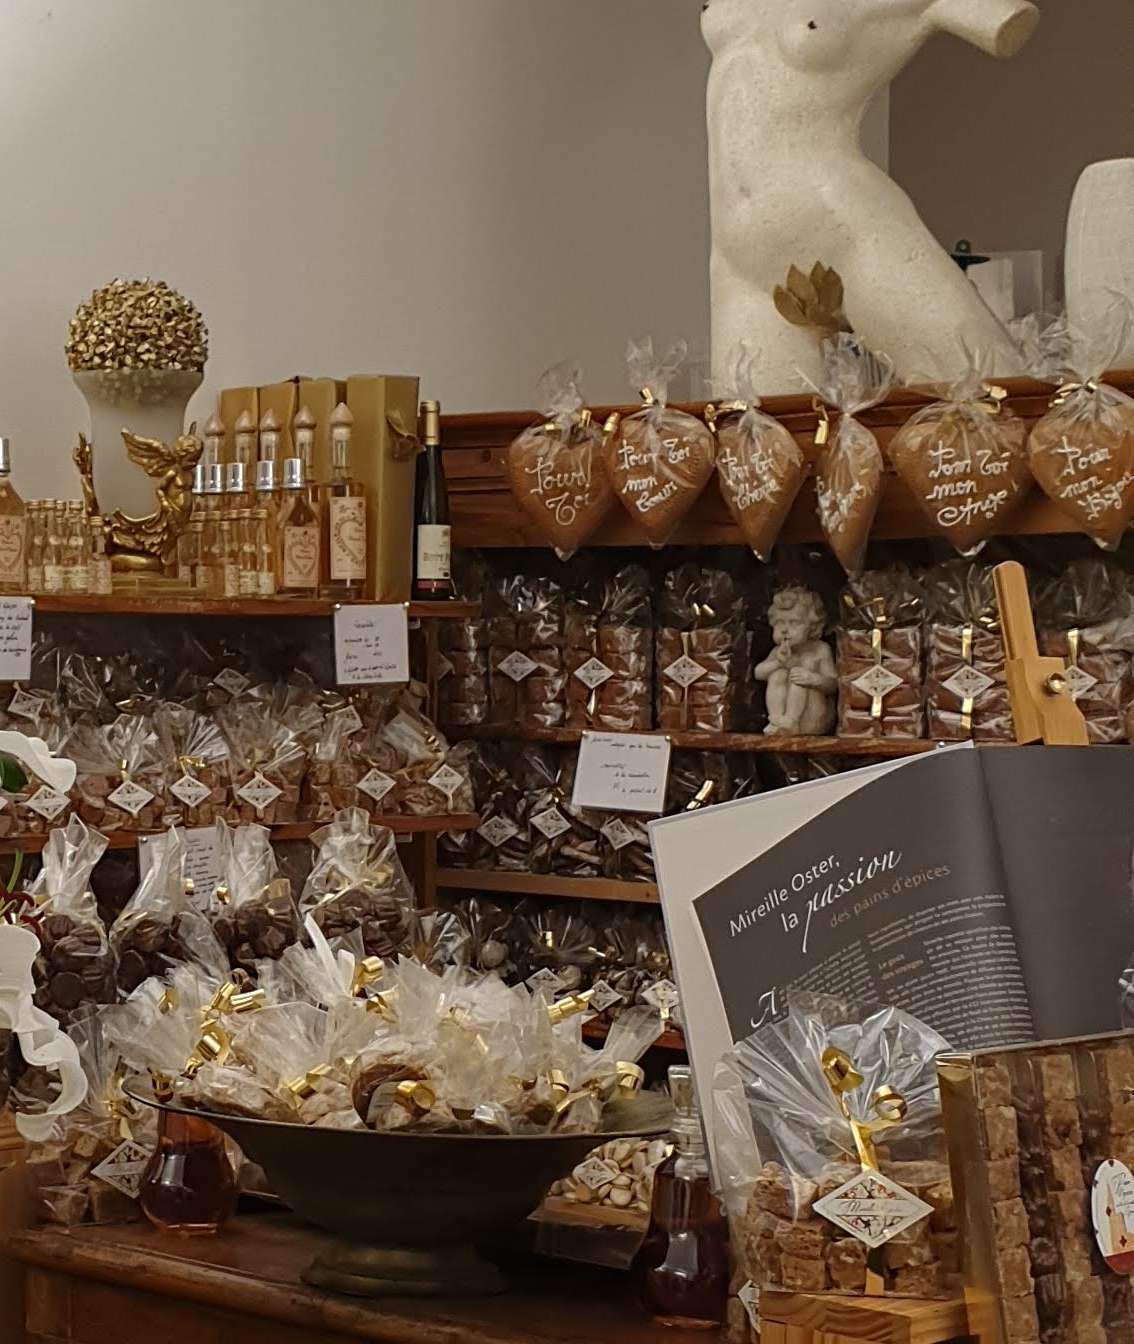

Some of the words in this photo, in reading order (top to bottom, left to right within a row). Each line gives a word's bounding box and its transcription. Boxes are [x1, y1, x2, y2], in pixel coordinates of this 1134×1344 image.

[622, 476, 658, 493] mon
[926, 481, 977, 499] mon
[1060, 477, 1104, 498] mon
[728, 889, 789, 937] Mireille
[791, 855, 840, 891] Oster,
[780, 912, 799, 932] la
[802, 850, 902, 953] passion
[829, 911, 851, 928] des
[853, 890, 889, 918] pains
[891, 864, 951, 895] d'épices
